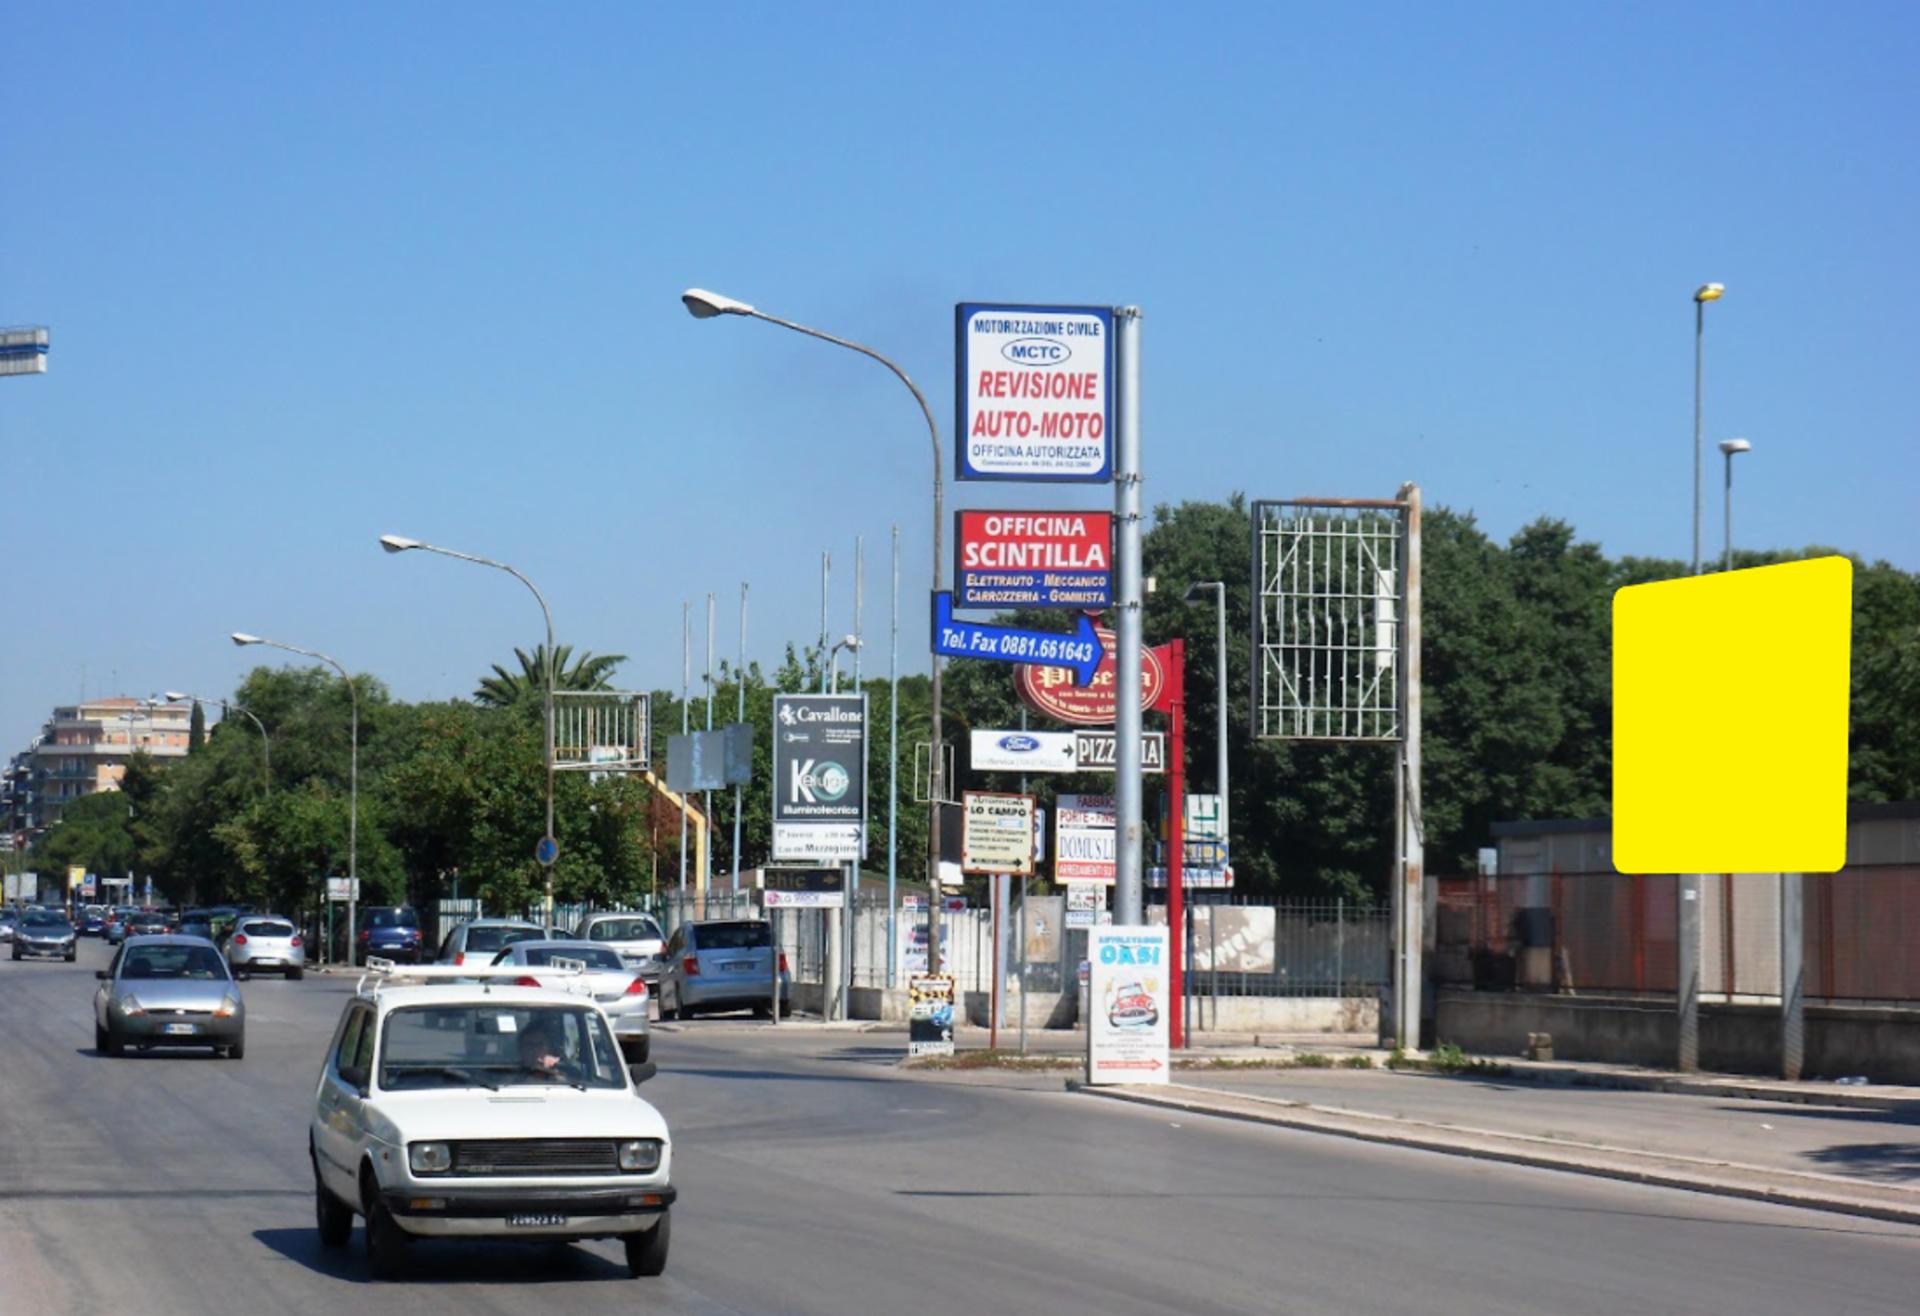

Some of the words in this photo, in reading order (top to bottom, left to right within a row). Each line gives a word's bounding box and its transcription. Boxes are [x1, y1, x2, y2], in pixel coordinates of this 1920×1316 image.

[974, 319, 1064, 335] MOTORIZZAZIONE
[1066, 322, 1099, 337] CIVILE
[1011, 345, 1061, 359] MCTC
[978, 370, 1098, 400] REVISIONE
[972, 410, 1104, 440] AUTO-MOTO
[972, 443, 1023, 458] OFFICINA
[1026, 445, 1101, 460] AUTORIZZATA
[984, 516, 1087, 537] OFFICINA
[964, 542, 1105, 567] SCINTILLA
[966, 573, 1034, 587] ELETTRAUTO
[1043, 574, 1107, 587] MECCANICO
[966, 590, 1039, 603] CARROZZERIA
[1049, 590, 1105, 603] GOMMISTA
[942, 628, 967, 649] Tel.
[970, 631, 999, 653] Fax
[1000, 635, 1094, 662] 0881.661643
[796, 706, 863, 723] Cavallone
[1078, 738, 1160, 764] PIZZIA
[970, 806, 985, 815] LO
[988, 806, 1027, 817] CAMPO
[1100, 945, 1160, 965] OASI
